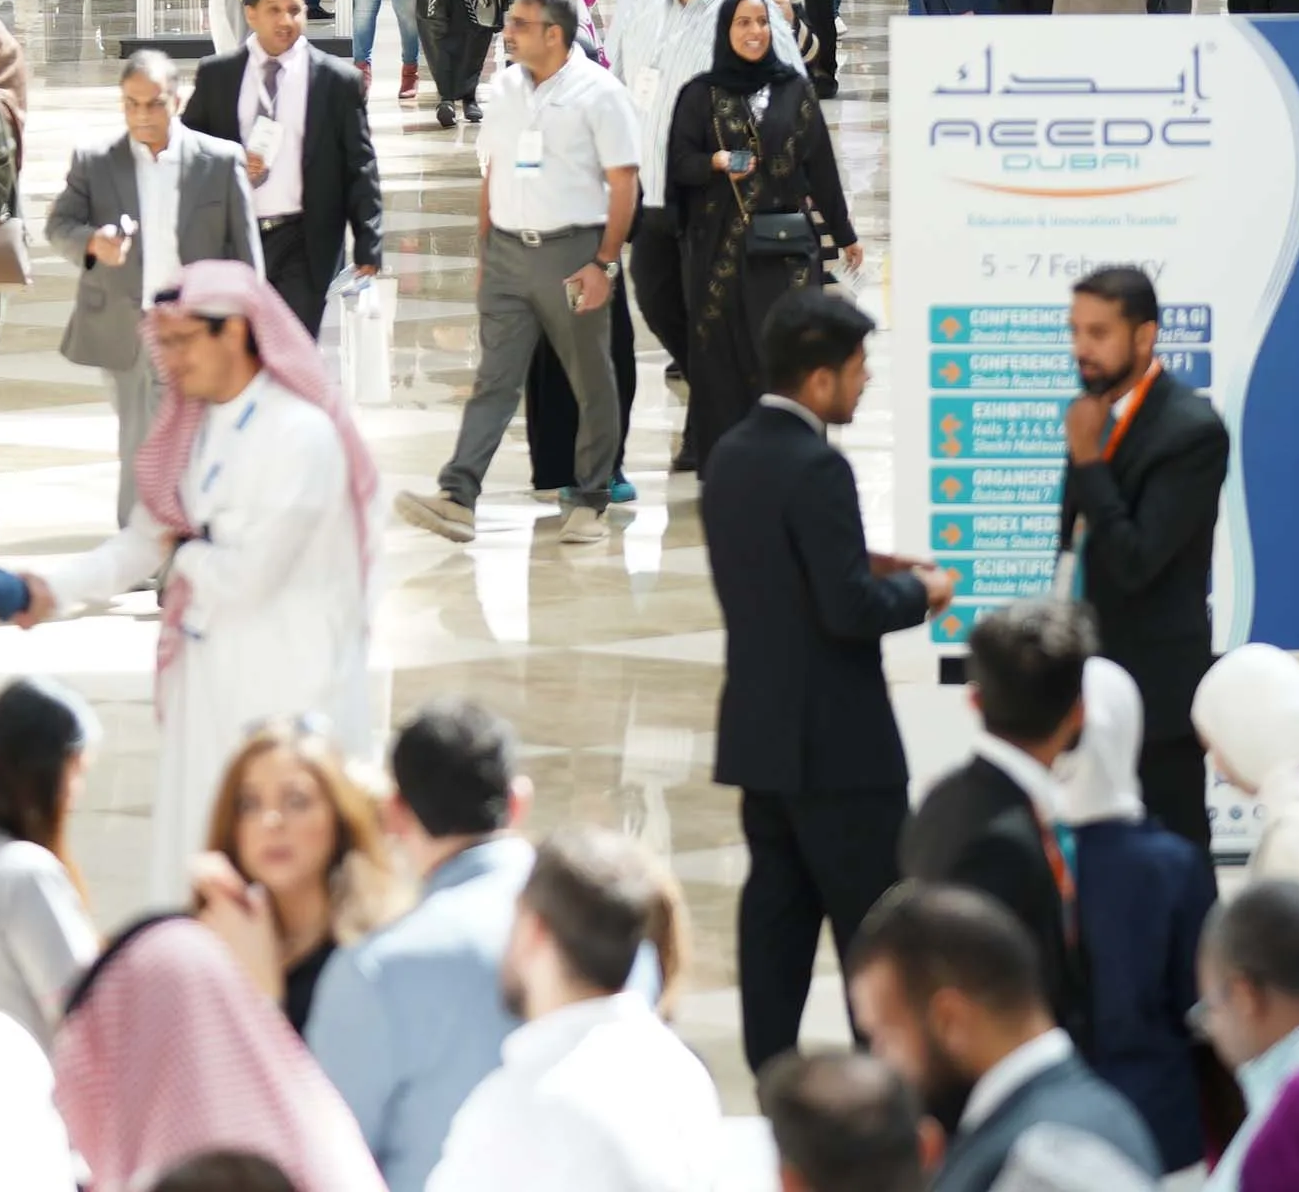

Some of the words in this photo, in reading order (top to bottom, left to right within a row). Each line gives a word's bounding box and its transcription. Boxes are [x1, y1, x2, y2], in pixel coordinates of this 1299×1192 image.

[931, 43, 1210, 115] إيدك
[929, 119, 1212, 147] AEEDC
[1002, 152, 1140, 171] DUBAI
[981, 253, 996, 278] 5
[1028, 253, 1042, 278] 7
[969, 308, 1069, 325] CONFERENCE
[969, 354, 1069, 371] CONFERENCE
[972, 402, 1059, 418] EXHIBITION
[972, 423, 1002, 436] Halls
[972, 516, 1018, 533] INDEX
[972, 560, 1054, 575] SCIENTIFIC
